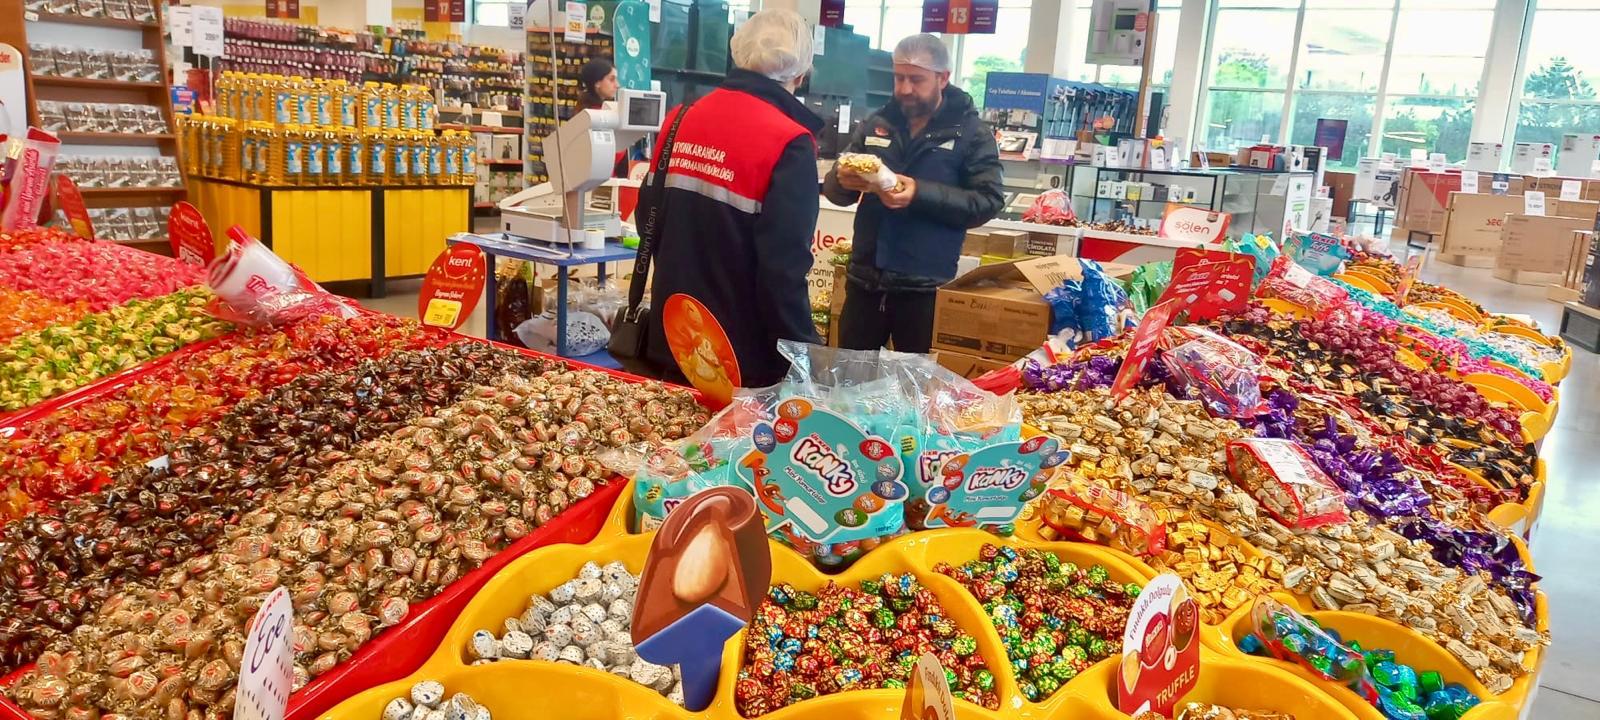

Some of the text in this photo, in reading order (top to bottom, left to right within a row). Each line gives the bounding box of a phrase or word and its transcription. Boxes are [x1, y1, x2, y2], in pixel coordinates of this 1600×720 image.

[950, 7, 968, 24] 13
[448, 255, 473, 267] kent
[636, 206, 657, 274] Calvin Klein
[250, 612, 285, 674] Ece
[1156, 664, 1195, 708] TRUFFLE
